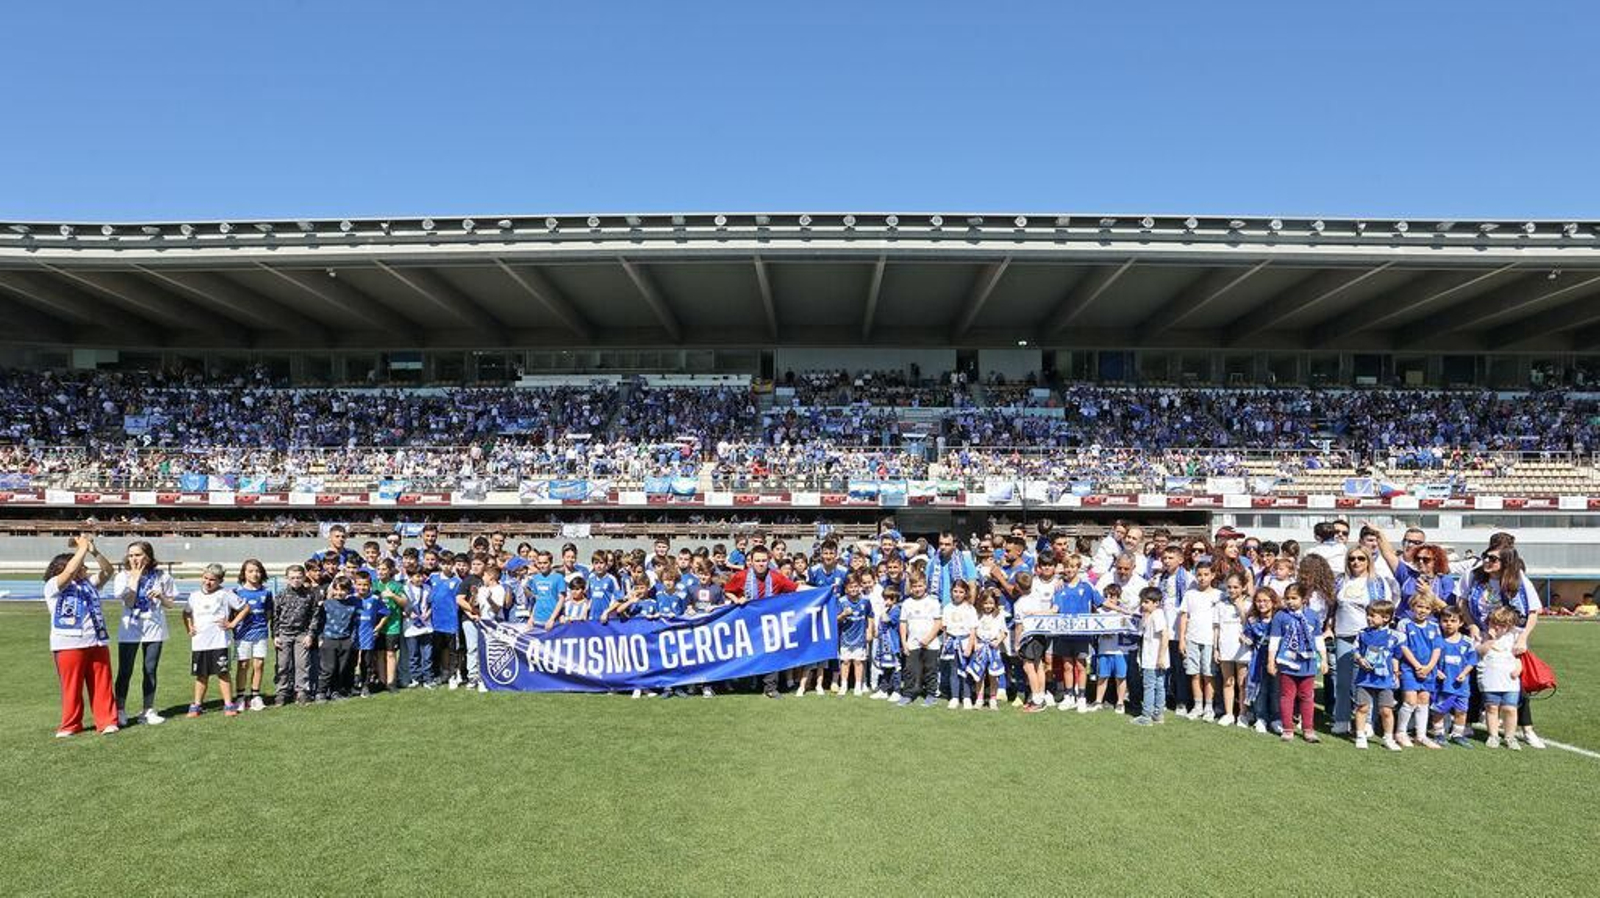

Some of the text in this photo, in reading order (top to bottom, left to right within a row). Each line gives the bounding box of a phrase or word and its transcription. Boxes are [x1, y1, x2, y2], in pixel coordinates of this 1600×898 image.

[527, 635, 650, 677] AUTISMO
[659, 621, 753, 669] CERCA
[762, 613, 799, 652] DE
[809, 605, 832, 643] TI
